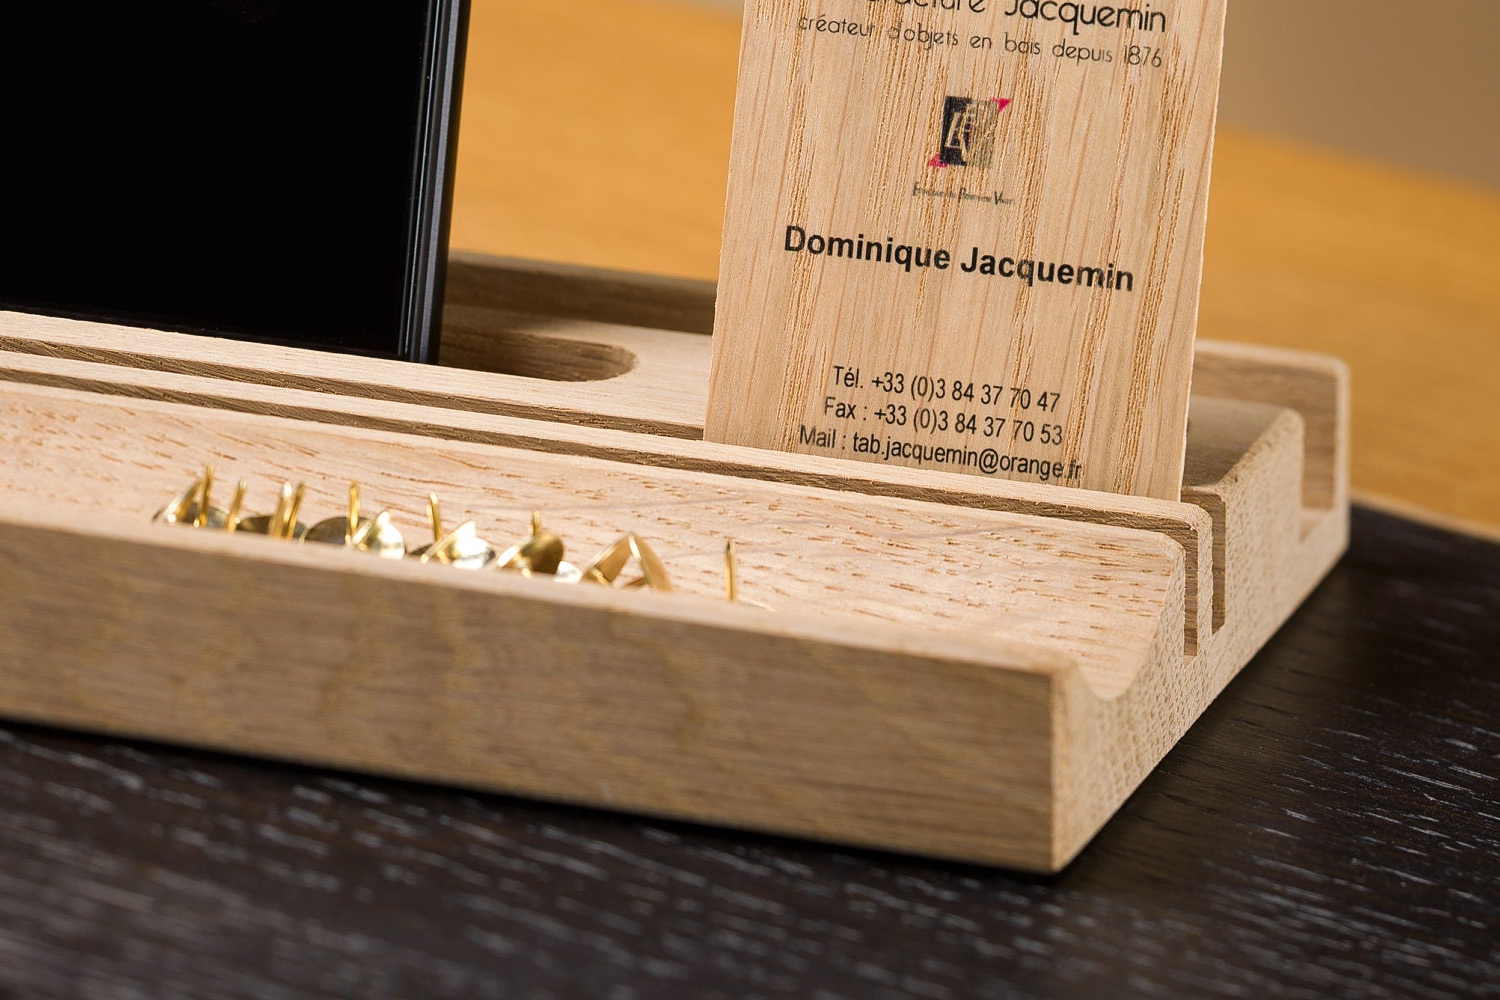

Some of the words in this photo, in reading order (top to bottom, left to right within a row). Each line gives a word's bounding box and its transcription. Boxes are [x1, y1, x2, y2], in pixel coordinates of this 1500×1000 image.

[799, 15, 875, 37] créateur
[969, 34, 992, 49] en
[1004, 31, 1041, 55] bois
[1052, 38, 1113, 66] depuis
[1123, 44, 1162, 68] 1876
[785, 225, 951, 272] Dominique
[960, 247, 1134, 292] Jacquemin
[833, 365, 863, 389] Tél.
[871, 372, 905, 393] +33
[911, 375, 946, 402] (0)3
[952, 380, 974, 402] 84
[981, 384, 1003, 405] 37
[1010, 387, 1031, 409] 70
[1037, 391, 1060, 413] 47
[823, 396, 857, 420] Fax
[863, 406, 868, 421] :
[874, 404, 907, 425] +33
[913, 408, 948, 435] (0)3
[955, 413, 977, 434] 84
[983, 416, 1006, 438] 37
[1013, 420, 1034, 442] 70
[1040, 423, 1062, 446] 53
[799, 424, 837, 449] Mail
[842, 435, 847, 450] :
[853, 432, 1082, 481] tab.jacquemin@orange.fr
